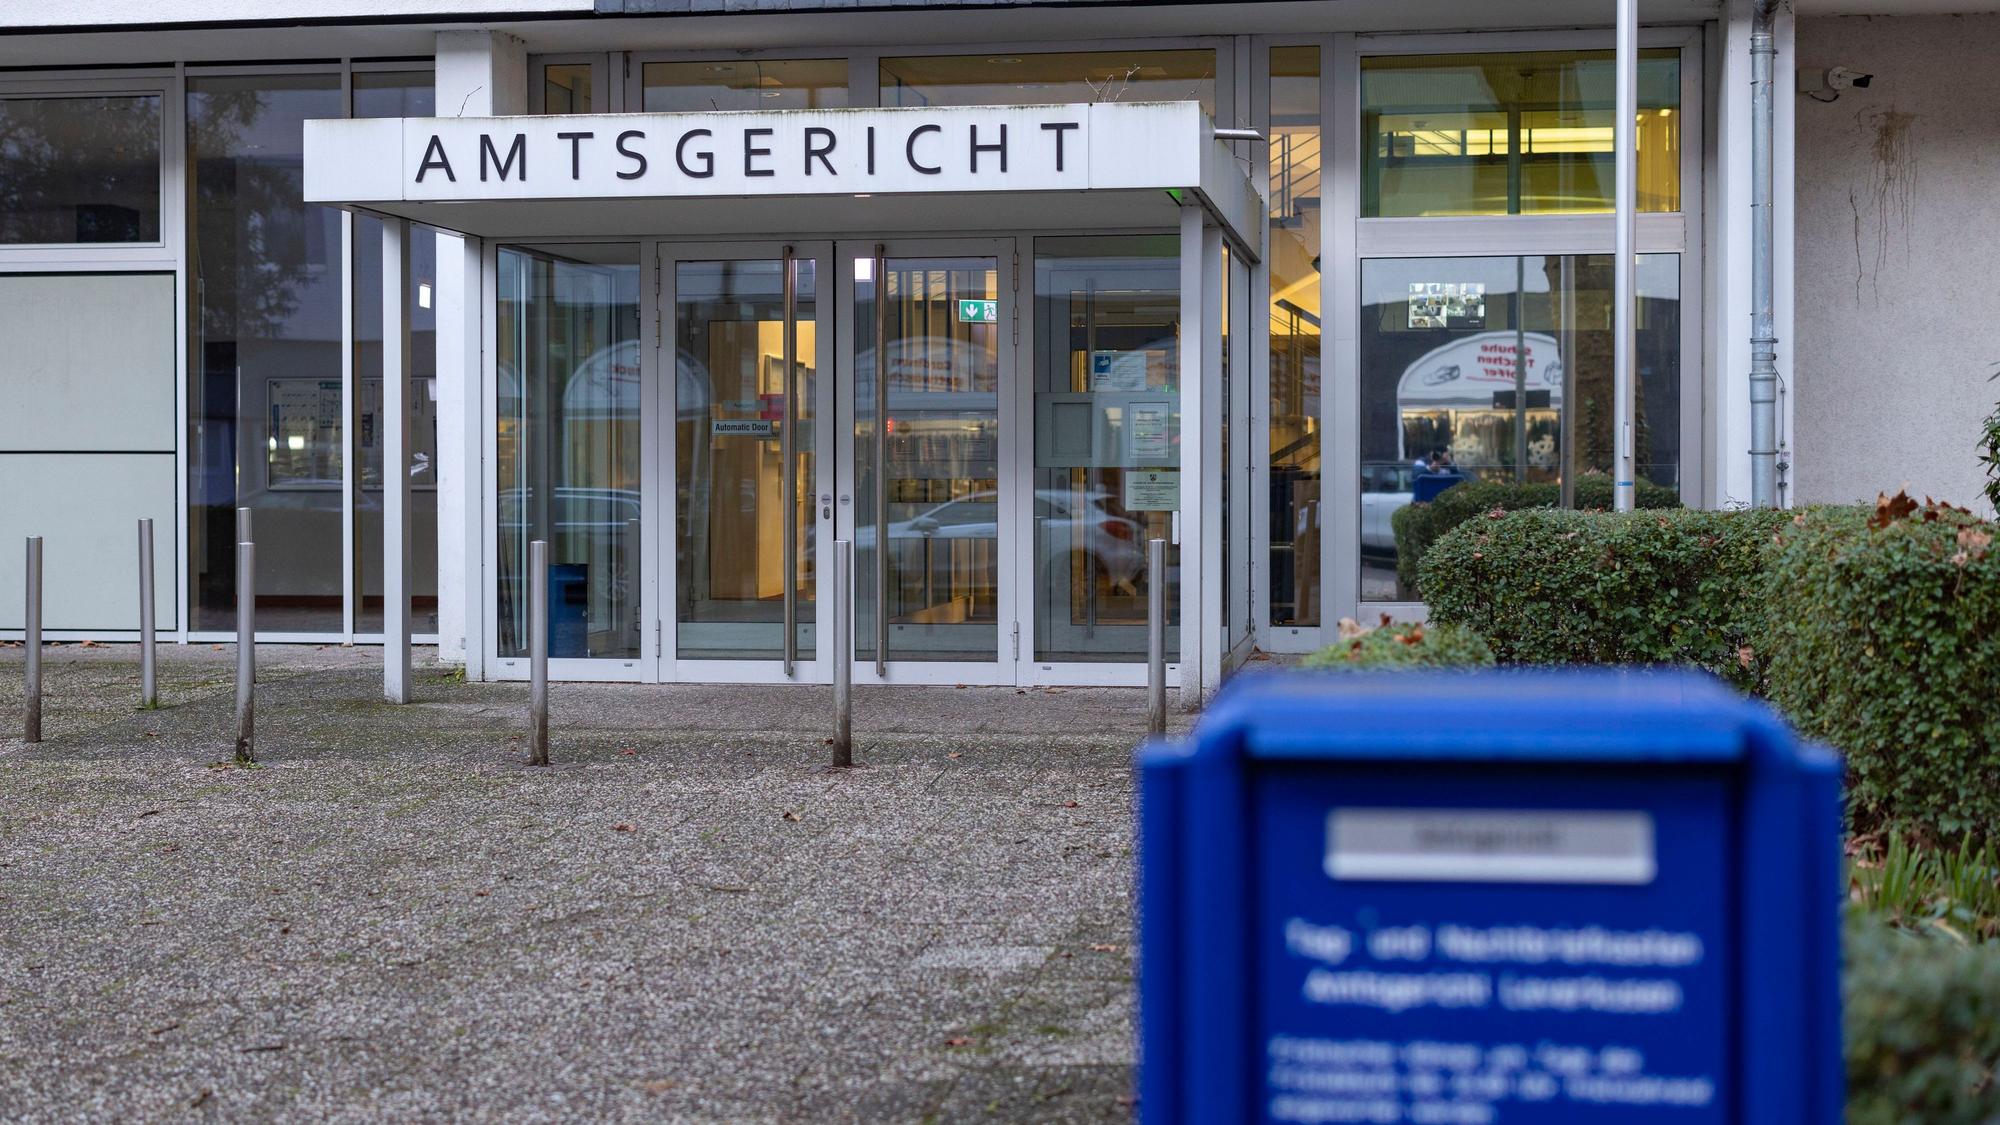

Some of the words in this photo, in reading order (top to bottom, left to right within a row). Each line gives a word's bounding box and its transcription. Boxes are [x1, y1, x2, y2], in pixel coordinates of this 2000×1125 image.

[415, 122, 1079, 184] AMTSGERICHT
[715, 423, 750, 432] Automatic
[752, 423, 768, 431] Door
